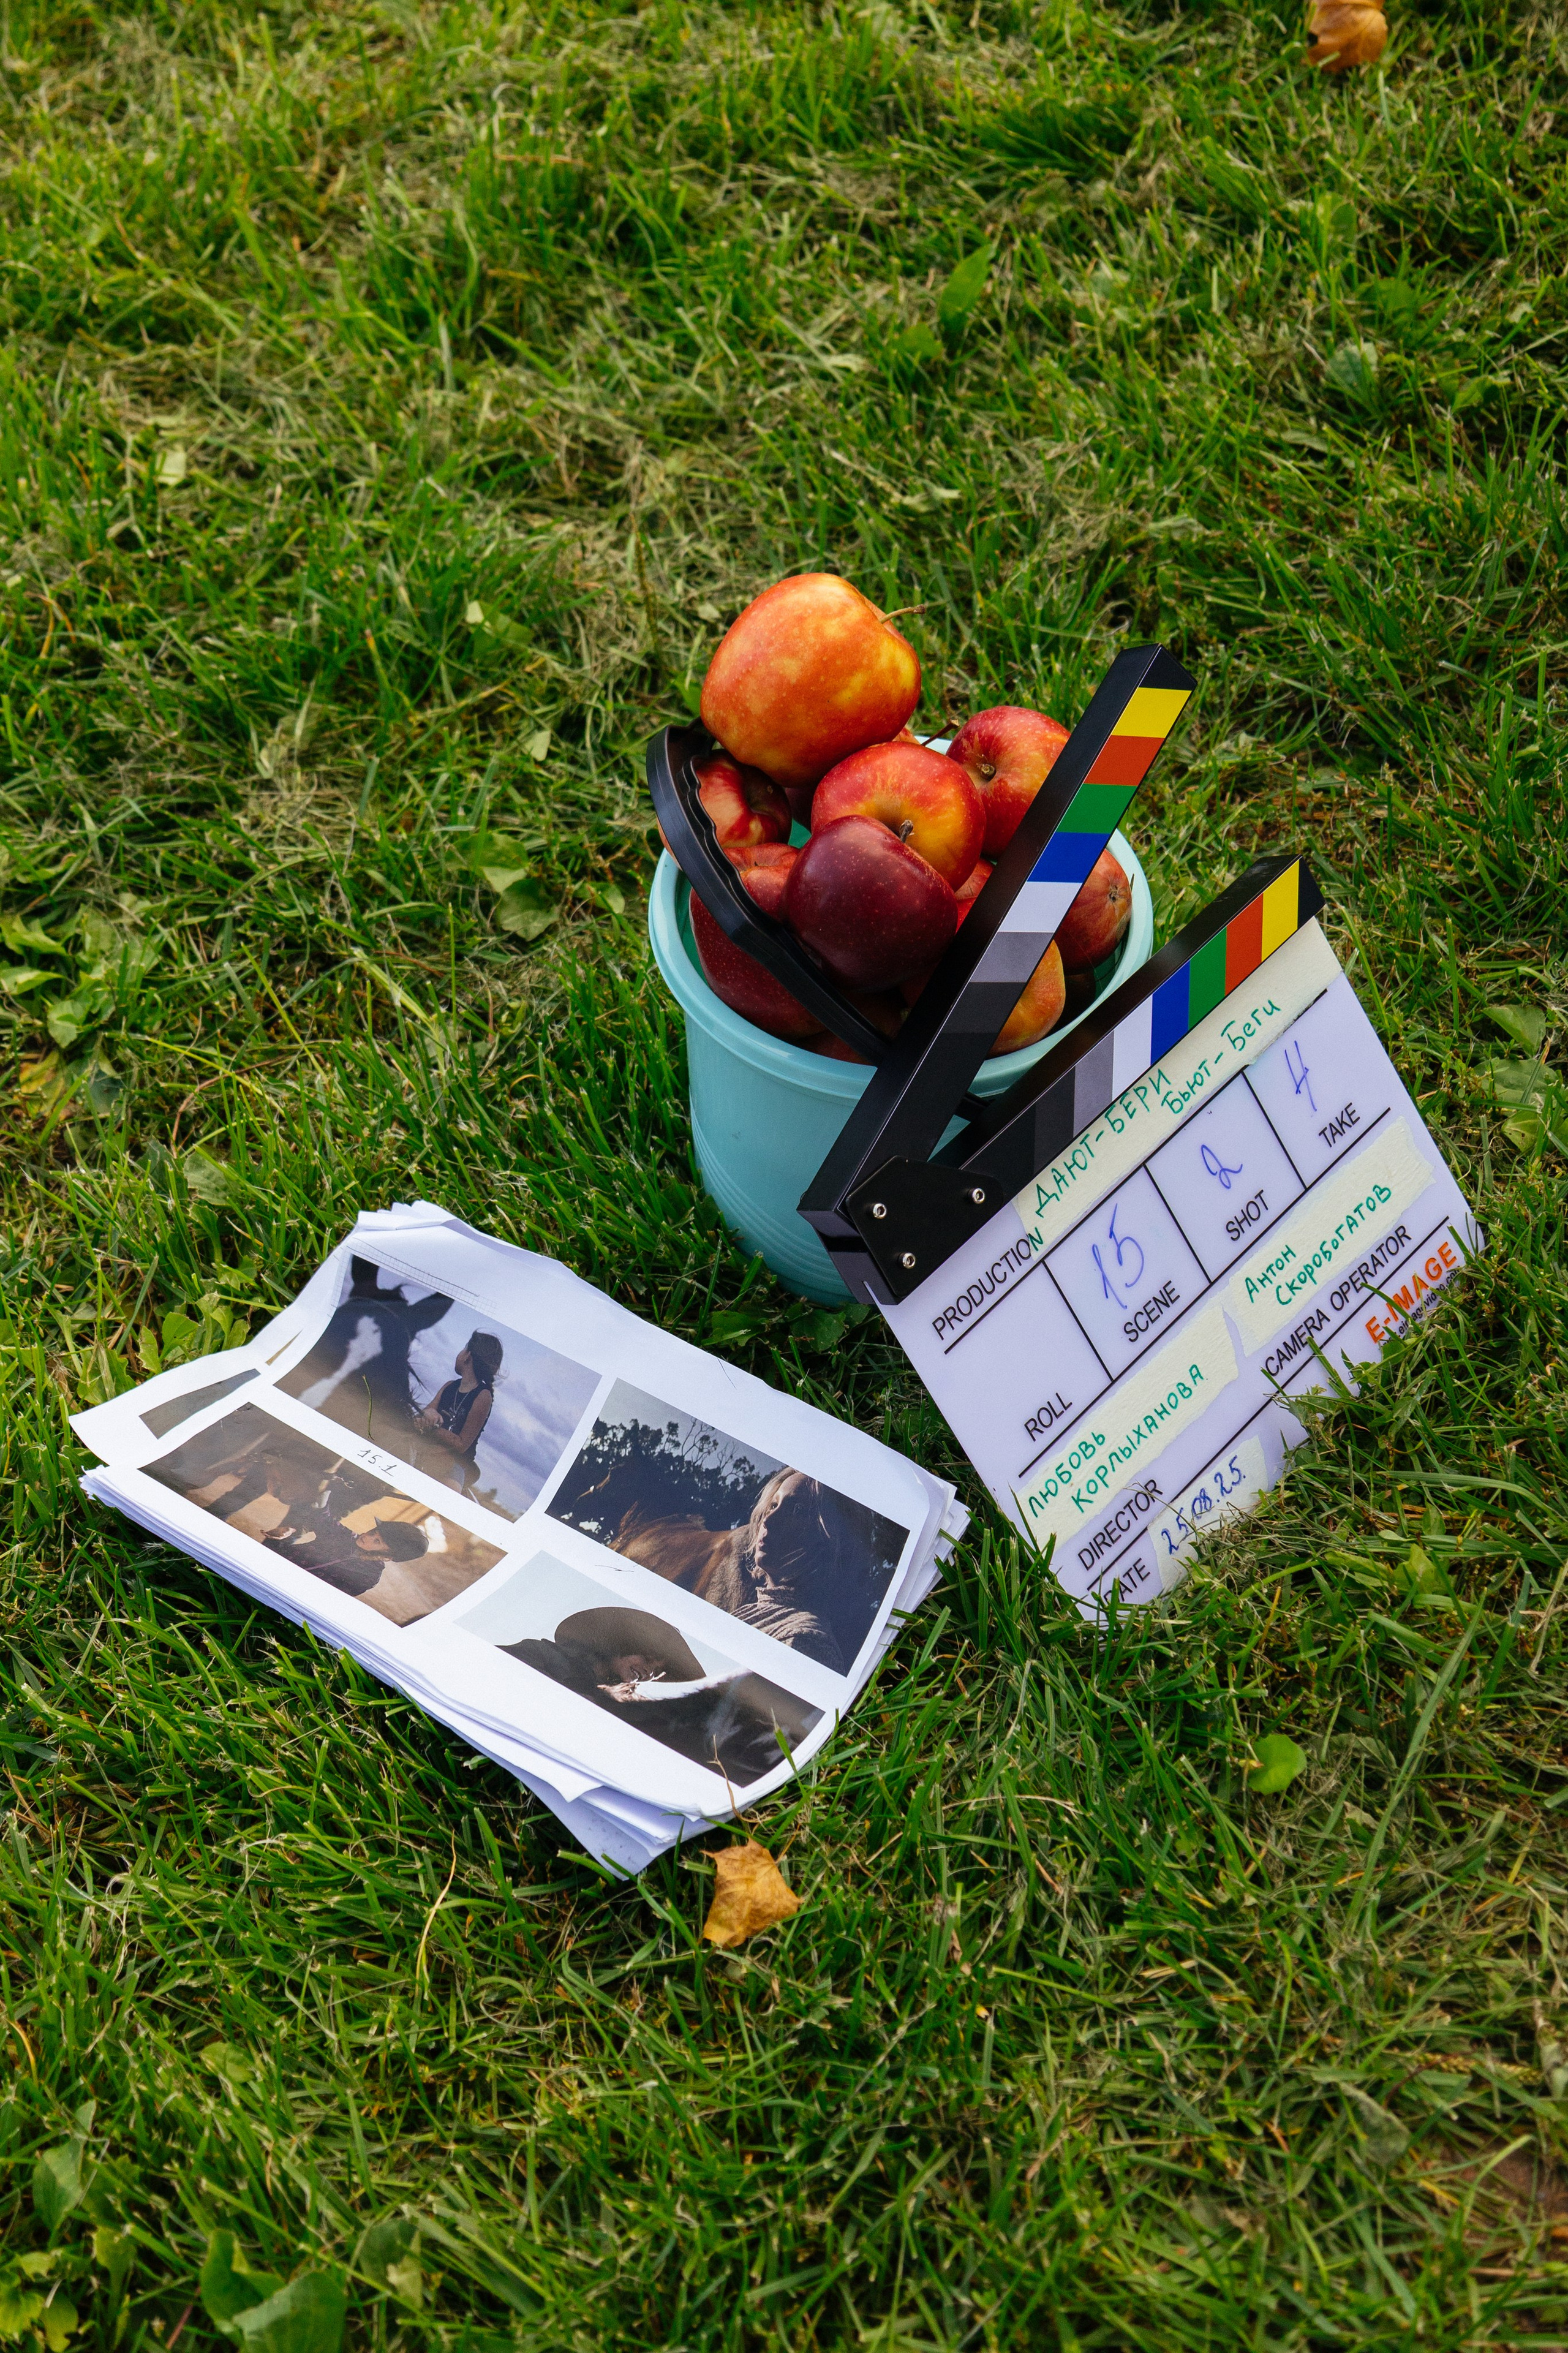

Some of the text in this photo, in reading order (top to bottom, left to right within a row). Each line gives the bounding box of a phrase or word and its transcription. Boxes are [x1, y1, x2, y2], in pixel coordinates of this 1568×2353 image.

[1284, 1040, 1317, 1112] 4
[1318, 1101, 1361, 1148] TAKE
[1200, 1144, 1243, 1190] 2
[1226, 1189, 1269, 1242] SHOT
[932, 1227, 1044, 1341] PRODUCTION
[1091, 1203, 1145, 1310] 15
[1365, 1241, 1457, 1344] E-IMAGE
[1123, 1280, 1181, 1343] SCENE
[1265, 1225, 1412, 1377] CAMERA OPERATOR
[1023, 1392, 1073, 1442] ROLL
[1077, 1479, 1164, 1571] DIRECTOR
